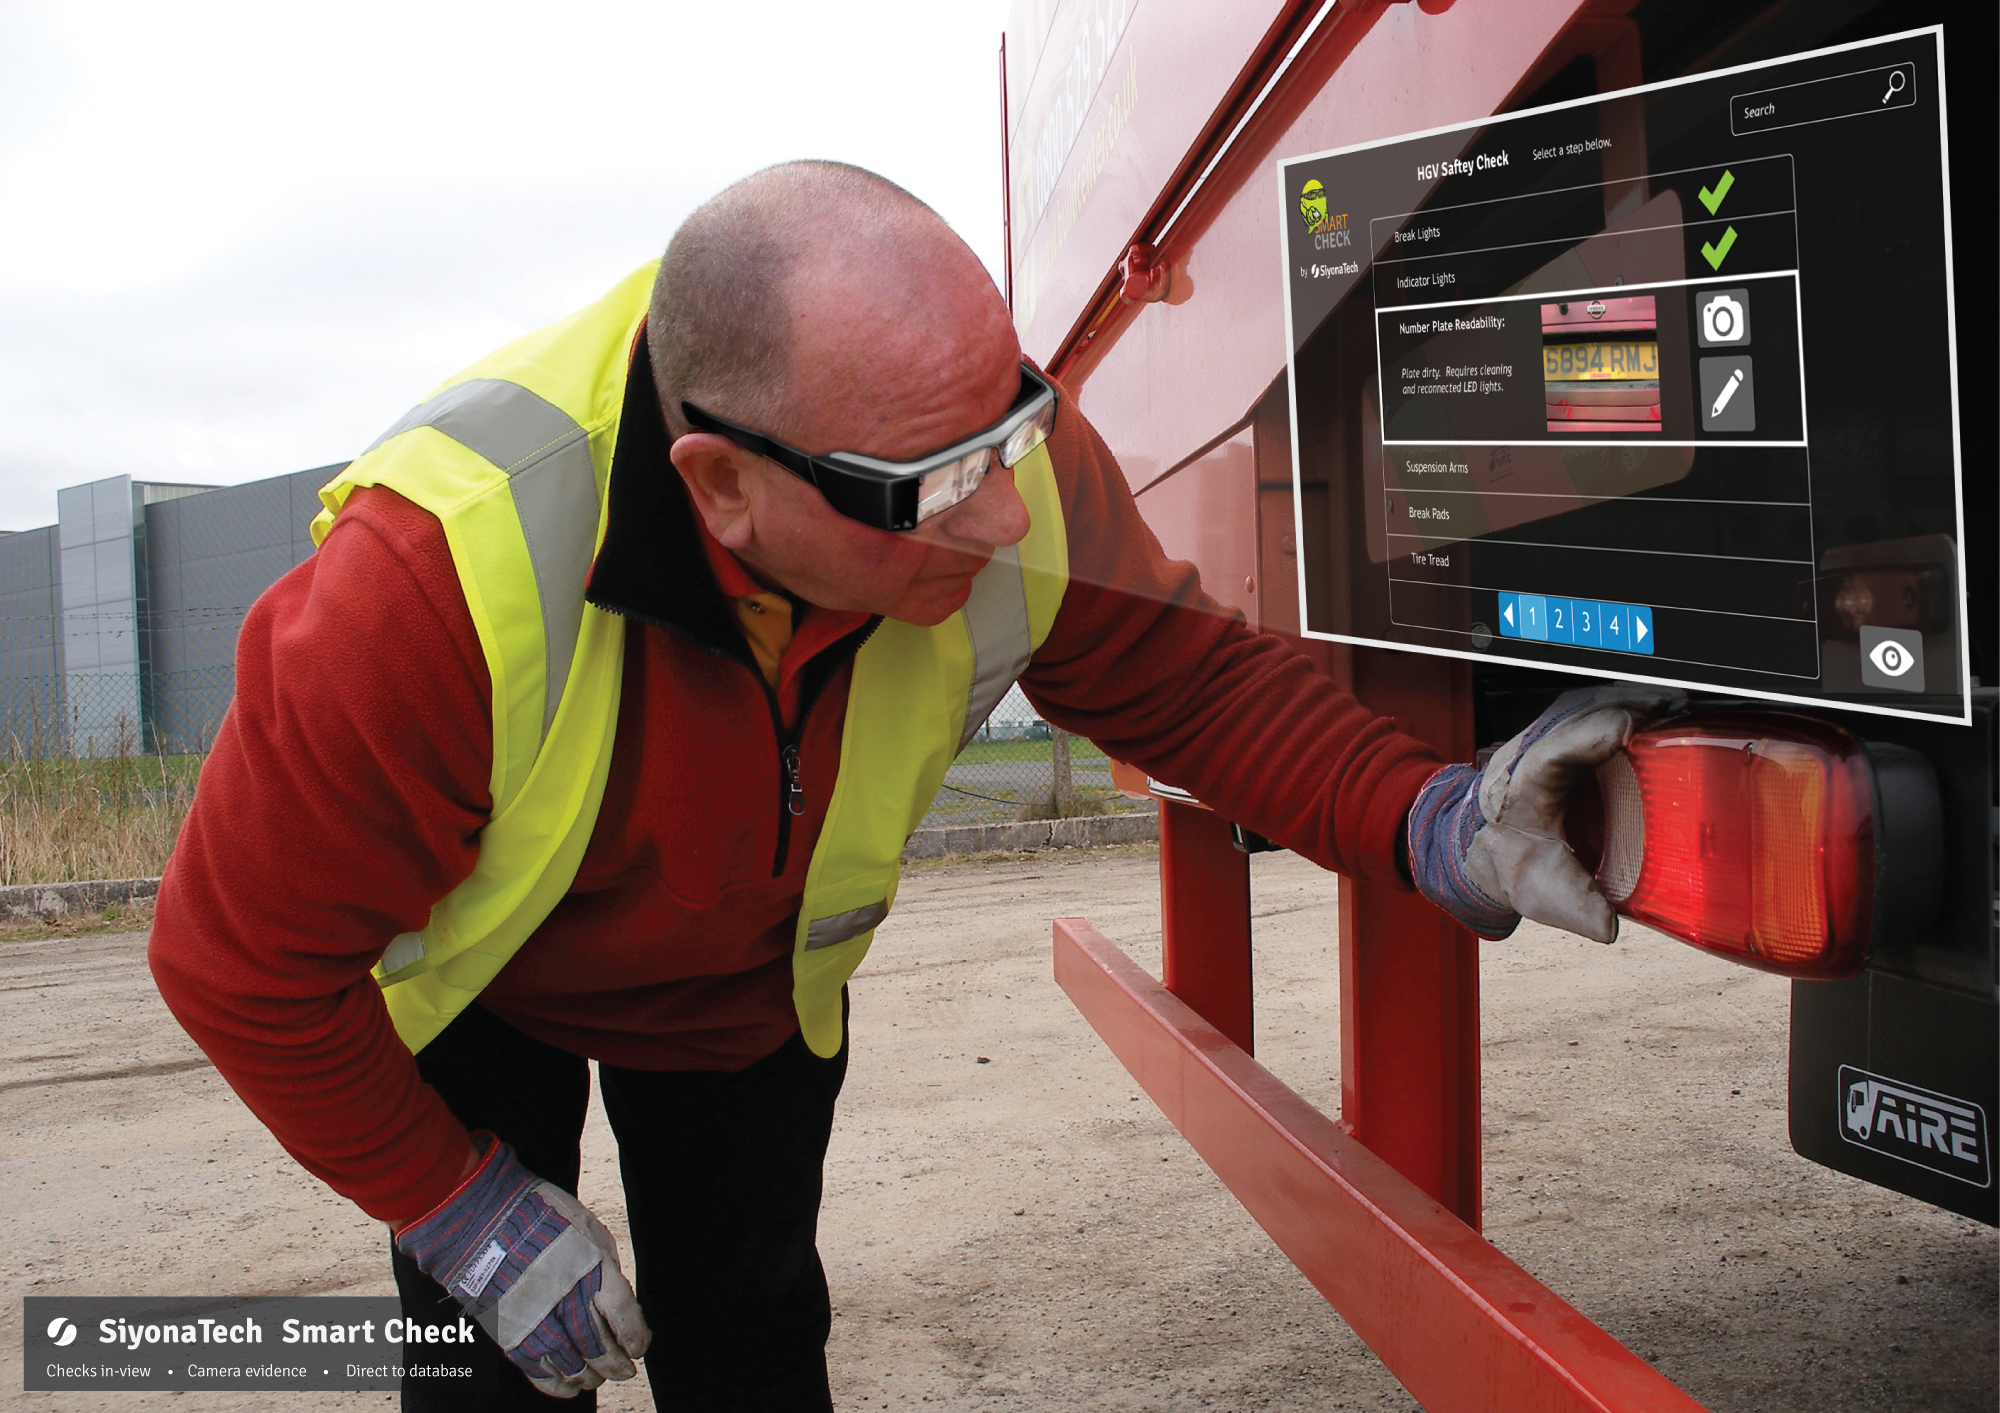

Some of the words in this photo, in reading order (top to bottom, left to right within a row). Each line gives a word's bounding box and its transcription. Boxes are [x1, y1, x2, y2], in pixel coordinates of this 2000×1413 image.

[1036, 92, 1064, 218] 0800
[1064, 20, 1091, 152] 529
[1744, 102, 1775, 119] Search
[1532, 147, 1557, 161] Select
[1558, 146, 1564, 156] a
[1565, 143, 1584, 155] step
[1585, 137, 1613, 151] below.
[1417, 163, 1440, 181] HGV
[1441, 158, 1474, 177] Saftey
[1476, 149, 1509, 171] Check
[1314, 213, 1348, 234] SMART
[1314, 229, 1351, 250] CHECK
[1394, 229, 1416, 243] Break
[1417, 226, 1441, 242] Lights
[1300, 266, 1308, 279] by
[1319, 260, 1359, 279] SiyonaTech
[1396, 276, 1431, 289] Indicator
[1432, 272, 1456, 288] Lights
[1399, 322, 1430, 334] Number
[1432, 320, 1454, 332] Plate
[1454, 315, 1505, 331] Readability:
[1610, 344, 1657, 373] RMJ
[1401, 368, 1421, 379] Plate
[1421, 367, 1441, 381] dirty.
[1445, 365, 1478, 379] Requires
[1479, 363, 1513, 378] cleaning
[1402, 383, 1416, 395] and
[1417, 381, 1462, 394] reconnected
[1463, 380, 1478, 393] LED
[1479, 380, 1504, 395] lights.
[1406, 460, 1448, 475] Suspension
[1449, 461, 1469, 474] Arms
[1408, 506, 1431, 519] Break
[1432, 507, 1450, 521] Pads
[1410, 551, 1427, 565] Tire
[1427, 553, 1450, 567] Tread
[1529, 606, 1536, 626] 1
[1554, 608, 1564, 629] 2
[1582, 611, 1591, 632] 3
[1609, 615, 1620, 635] 4
